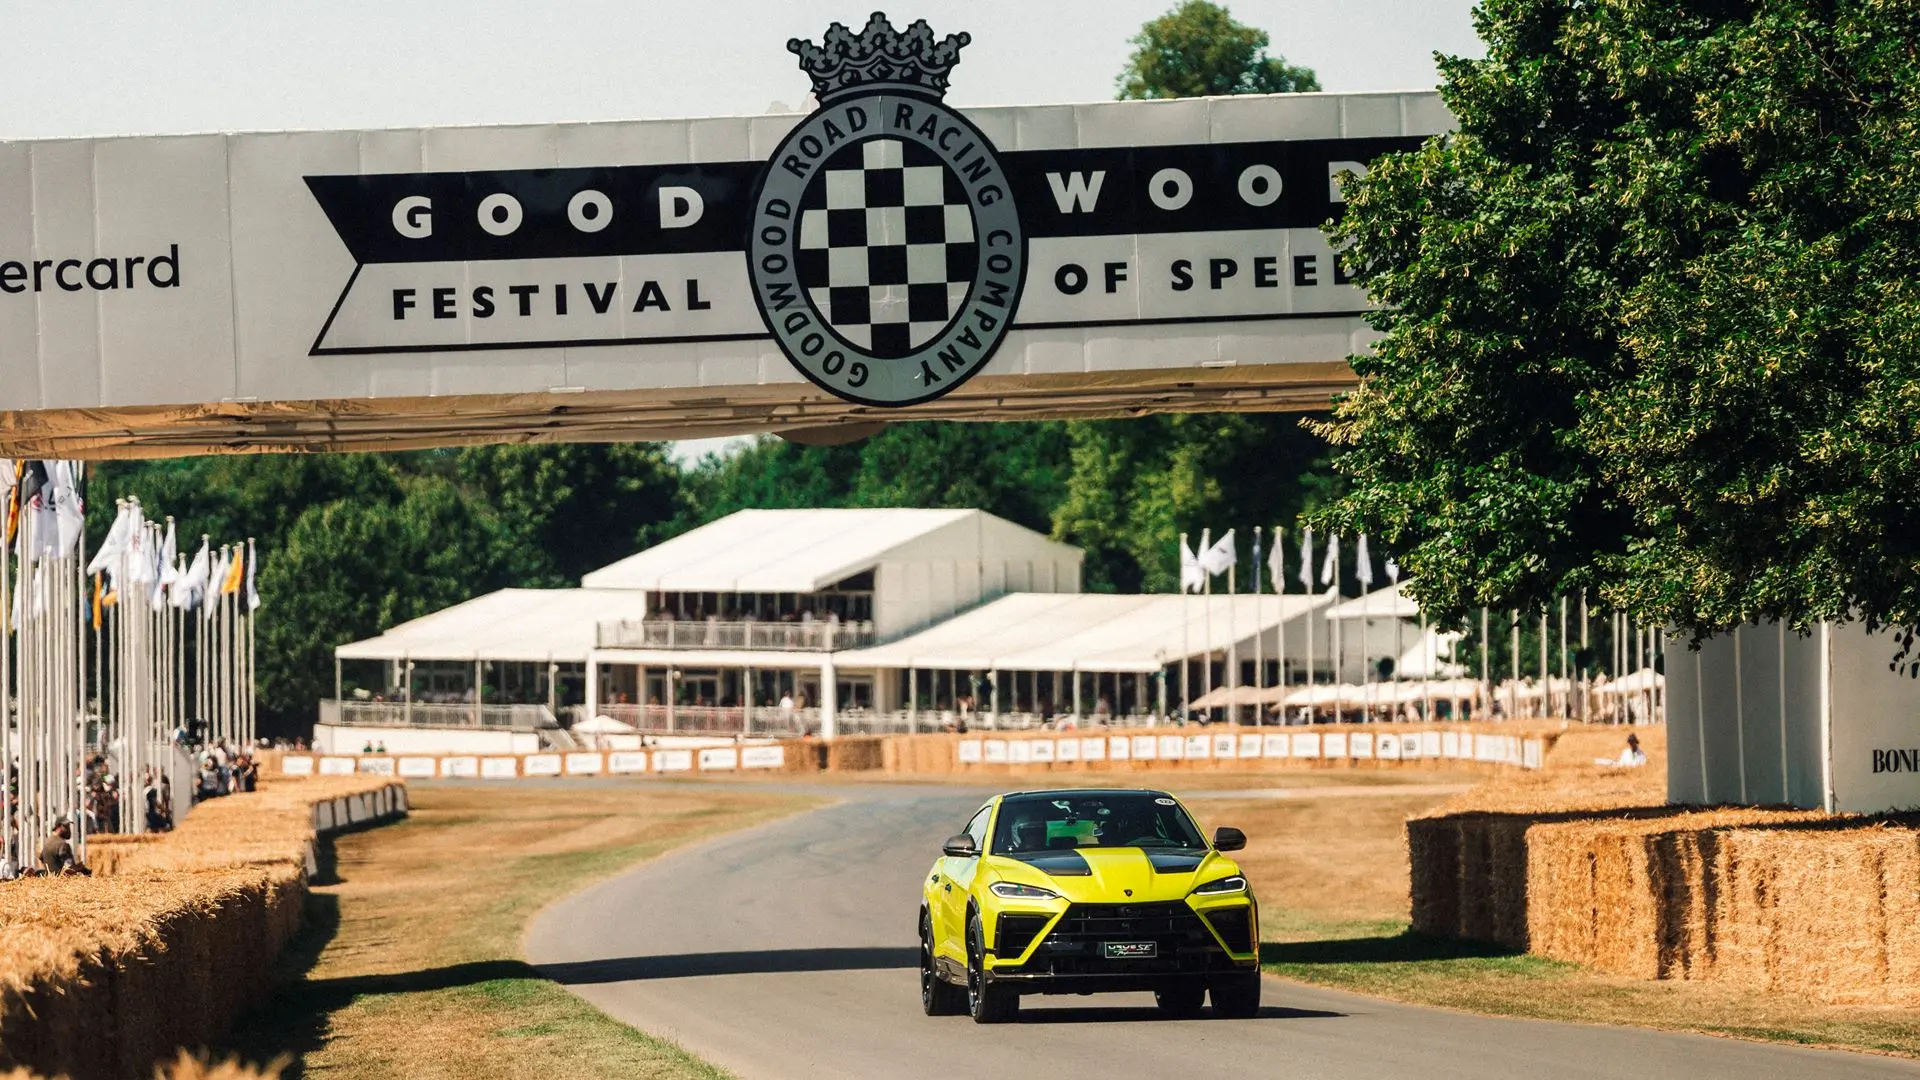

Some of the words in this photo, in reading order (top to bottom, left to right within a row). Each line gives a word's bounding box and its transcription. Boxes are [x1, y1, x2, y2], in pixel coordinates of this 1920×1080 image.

[781, 106, 868, 179] ROAD
[893, 103, 1003, 207] RACING
[393, 187, 704, 238] GOOD
[0, 243, 180, 294] ercard
[393, 278, 712, 321] FESTIVAL
[1055, 261, 1128, 296] OF
[761, 198, 869, 388] GOODWOOD
[920, 229, 1013, 387] COMPANY
